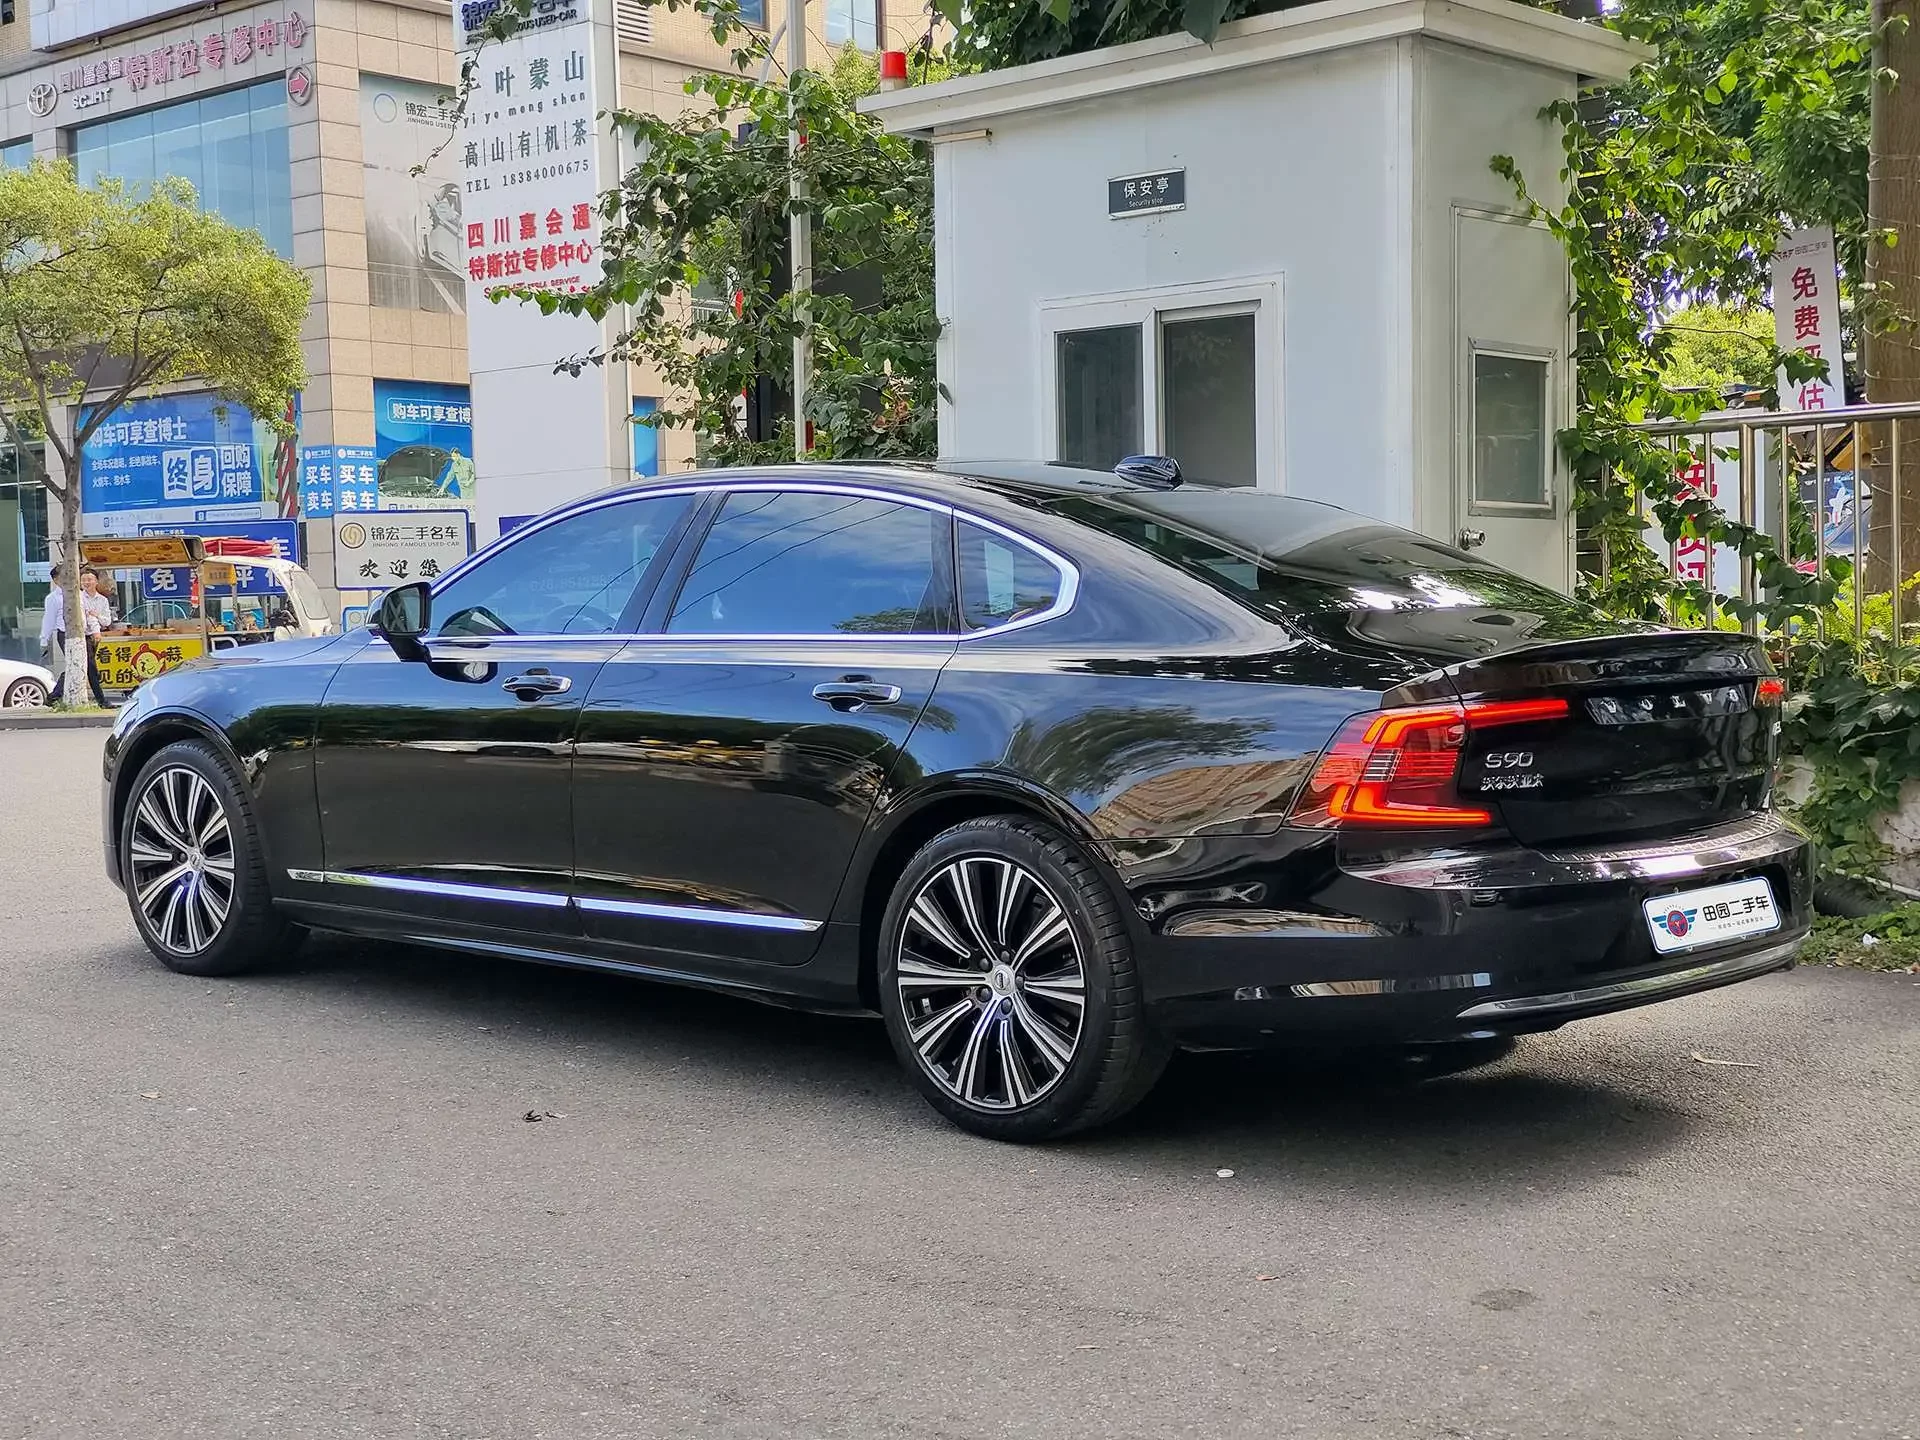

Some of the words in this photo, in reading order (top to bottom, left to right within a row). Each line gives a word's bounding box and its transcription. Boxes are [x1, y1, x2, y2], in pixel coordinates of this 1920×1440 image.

[123, 10, 307, 92] 特斯拉专修中心
[552, 92, 586, 107] shan
[466, 178, 491, 193] TEL
[503, 159, 590, 187] 18384000675
[1124, 176, 1169, 199] 保安亭
[467, 203, 591, 249] 四川嘉会通
[468, 239, 593, 281] 特斯拉专修中心
[220, 444, 250, 470] 回购
[167, 454, 215, 493] 终身
[221, 471, 252, 498] 保障
[305, 464, 333, 486] 买车
[339, 464, 375, 485] 买车
[306, 491, 334, 512] 卖车
[341, 490, 377, 511] 卖车
[370, 525, 459, 541] 锦宏二手名车
[359, 558, 442, 579] 欢迎您
[166, 645, 183, 662] 蒜
[1600, 688, 1740, 714] VOLVO
[1484, 752, 1533, 768] S90
[1702, 895, 1770, 922] 田园二手车
